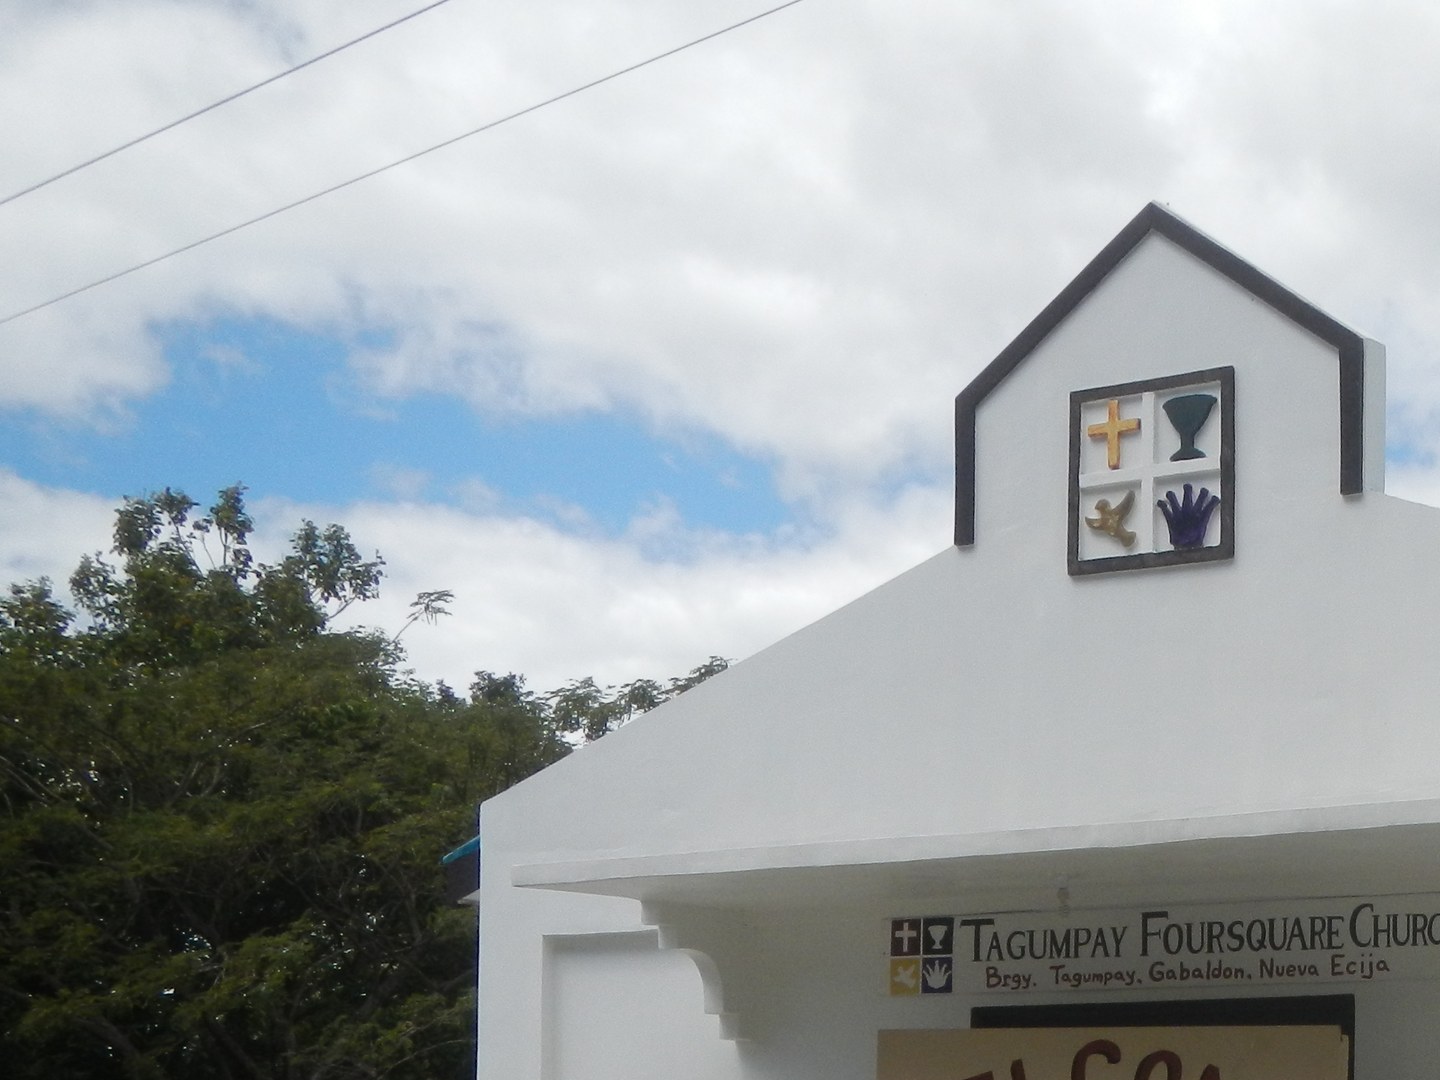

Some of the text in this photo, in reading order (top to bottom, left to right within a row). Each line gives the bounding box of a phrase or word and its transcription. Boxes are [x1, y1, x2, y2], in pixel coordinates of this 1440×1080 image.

[1140, 910, 1345, 957] FOURSQUARE
[985, 966, 1037, 990] Brgy.
[1259, 958, 1320, 979] Nueva
[1330, 953, 1390, 979] Ecija
